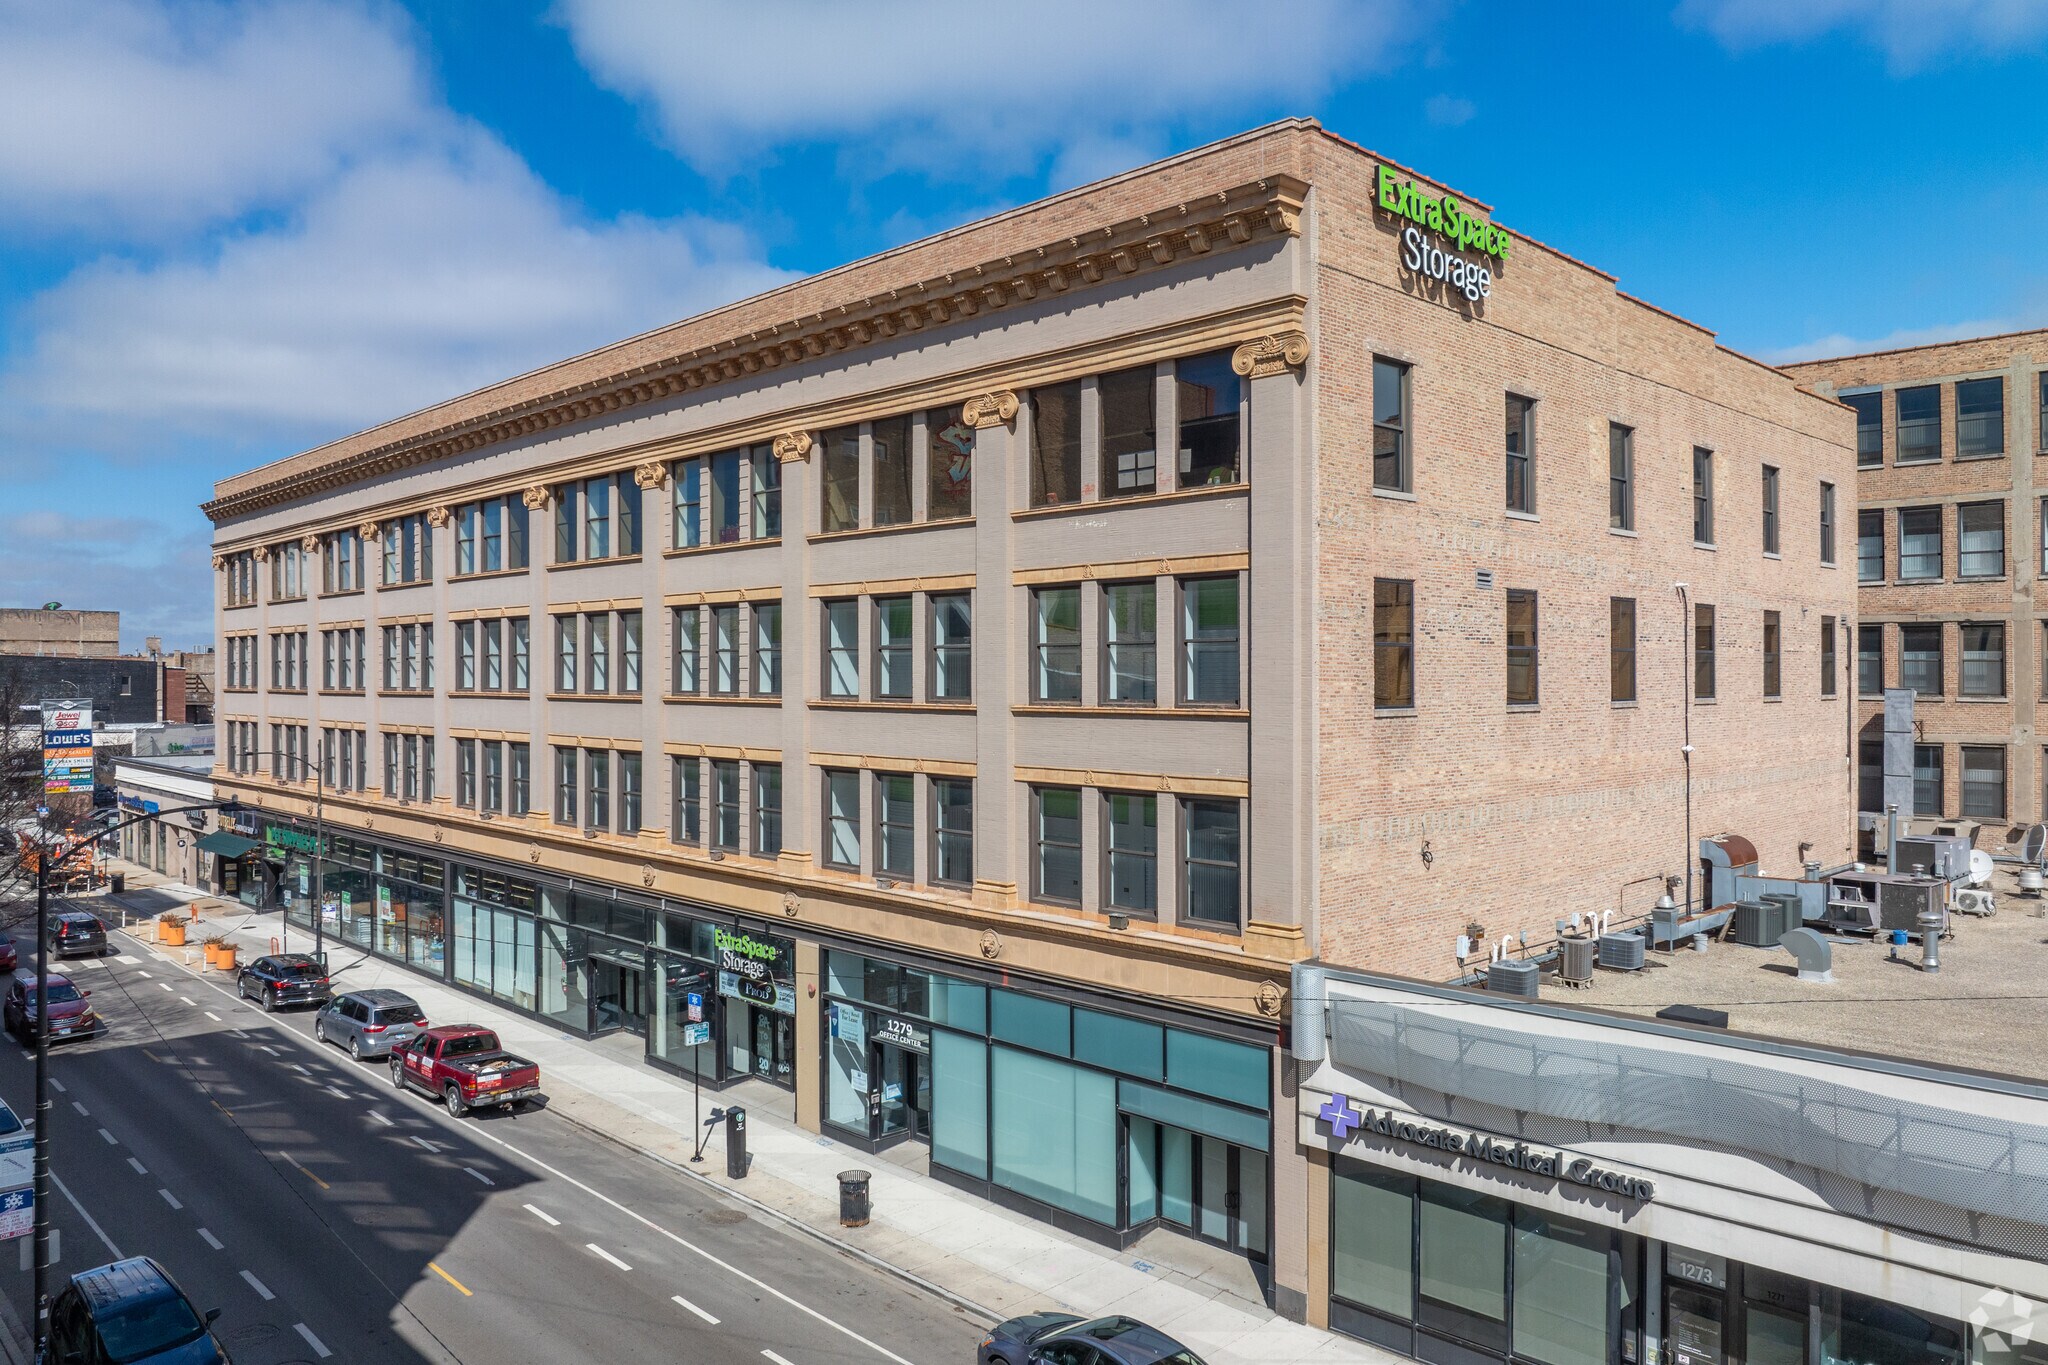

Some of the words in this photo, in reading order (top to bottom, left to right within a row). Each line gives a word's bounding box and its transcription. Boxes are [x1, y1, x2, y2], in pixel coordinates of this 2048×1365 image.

[1403, 227, 1491, 301] Storage
[45, 734, 90, 744] LOWE'S
[722, 950, 764, 979] Storage
[745, 982, 770, 1000] PROD
[887, 1019, 913, 1036] 1279
[879, 1030, 899, 1042] OFFICE
[900, 1036, 922, 1048] CENTER
[1361, 1108, 1463, 1152] Advocate
[1465, 1133, 1564, 1179] Medical
[1568, 1158, 1655, 1201] Group
[1679, 1262, 1713, 1284] 1273
[1767, 1290, 1785, 1301] 1271
